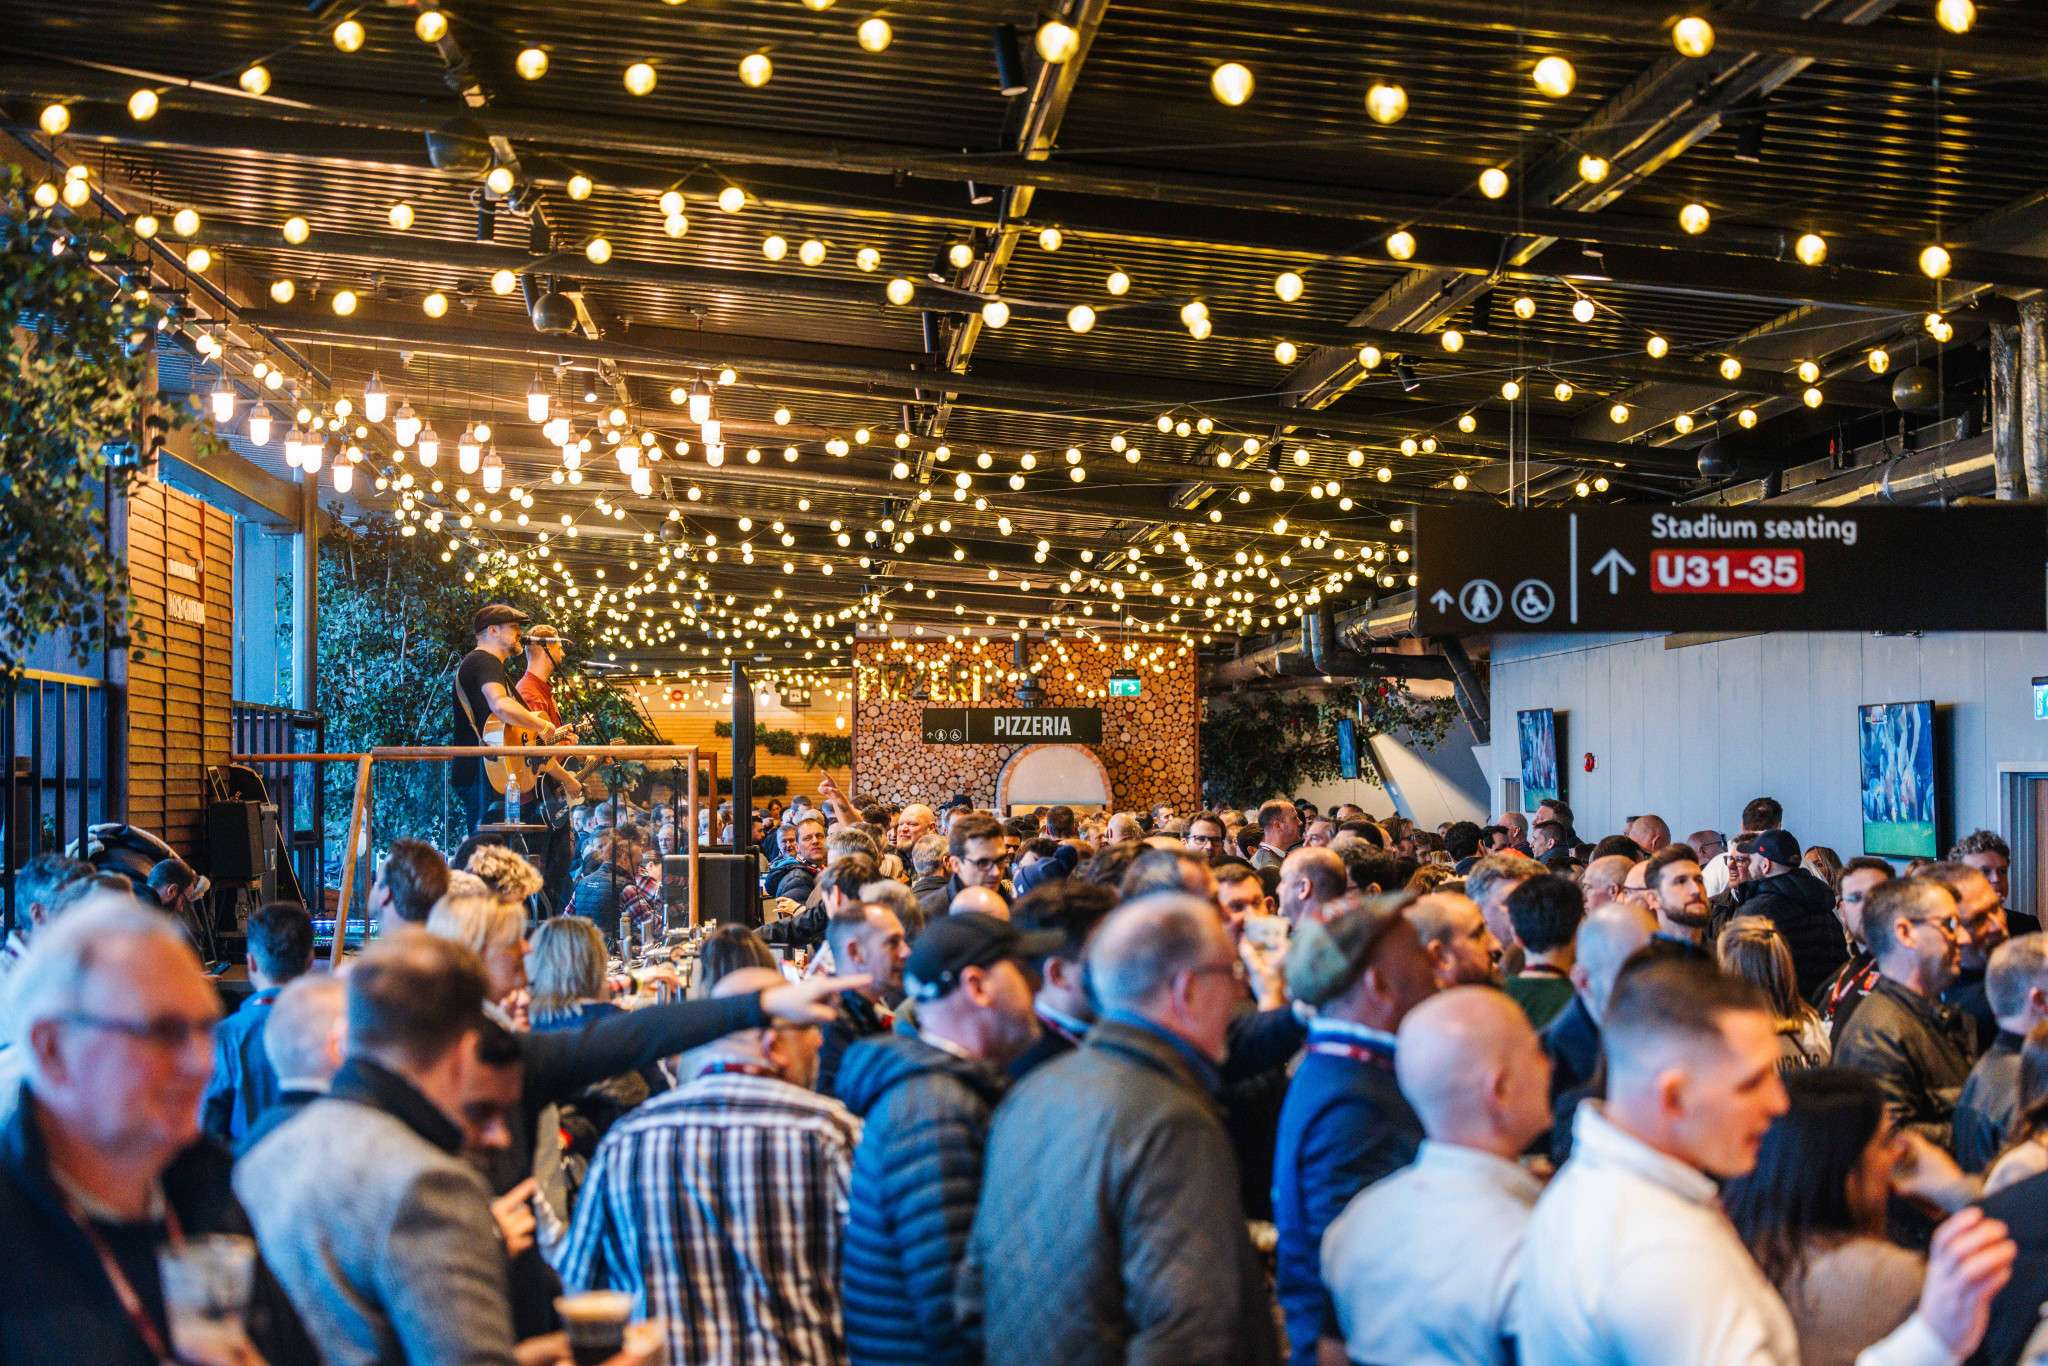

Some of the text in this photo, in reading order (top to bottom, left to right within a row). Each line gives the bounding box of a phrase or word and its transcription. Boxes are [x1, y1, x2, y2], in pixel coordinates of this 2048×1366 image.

[1651, 513, 1858, 546] Stadium seating
[1656, 554, 1799, 588] U31-35
[993, 715, 1072, 736] PIZZERIA
